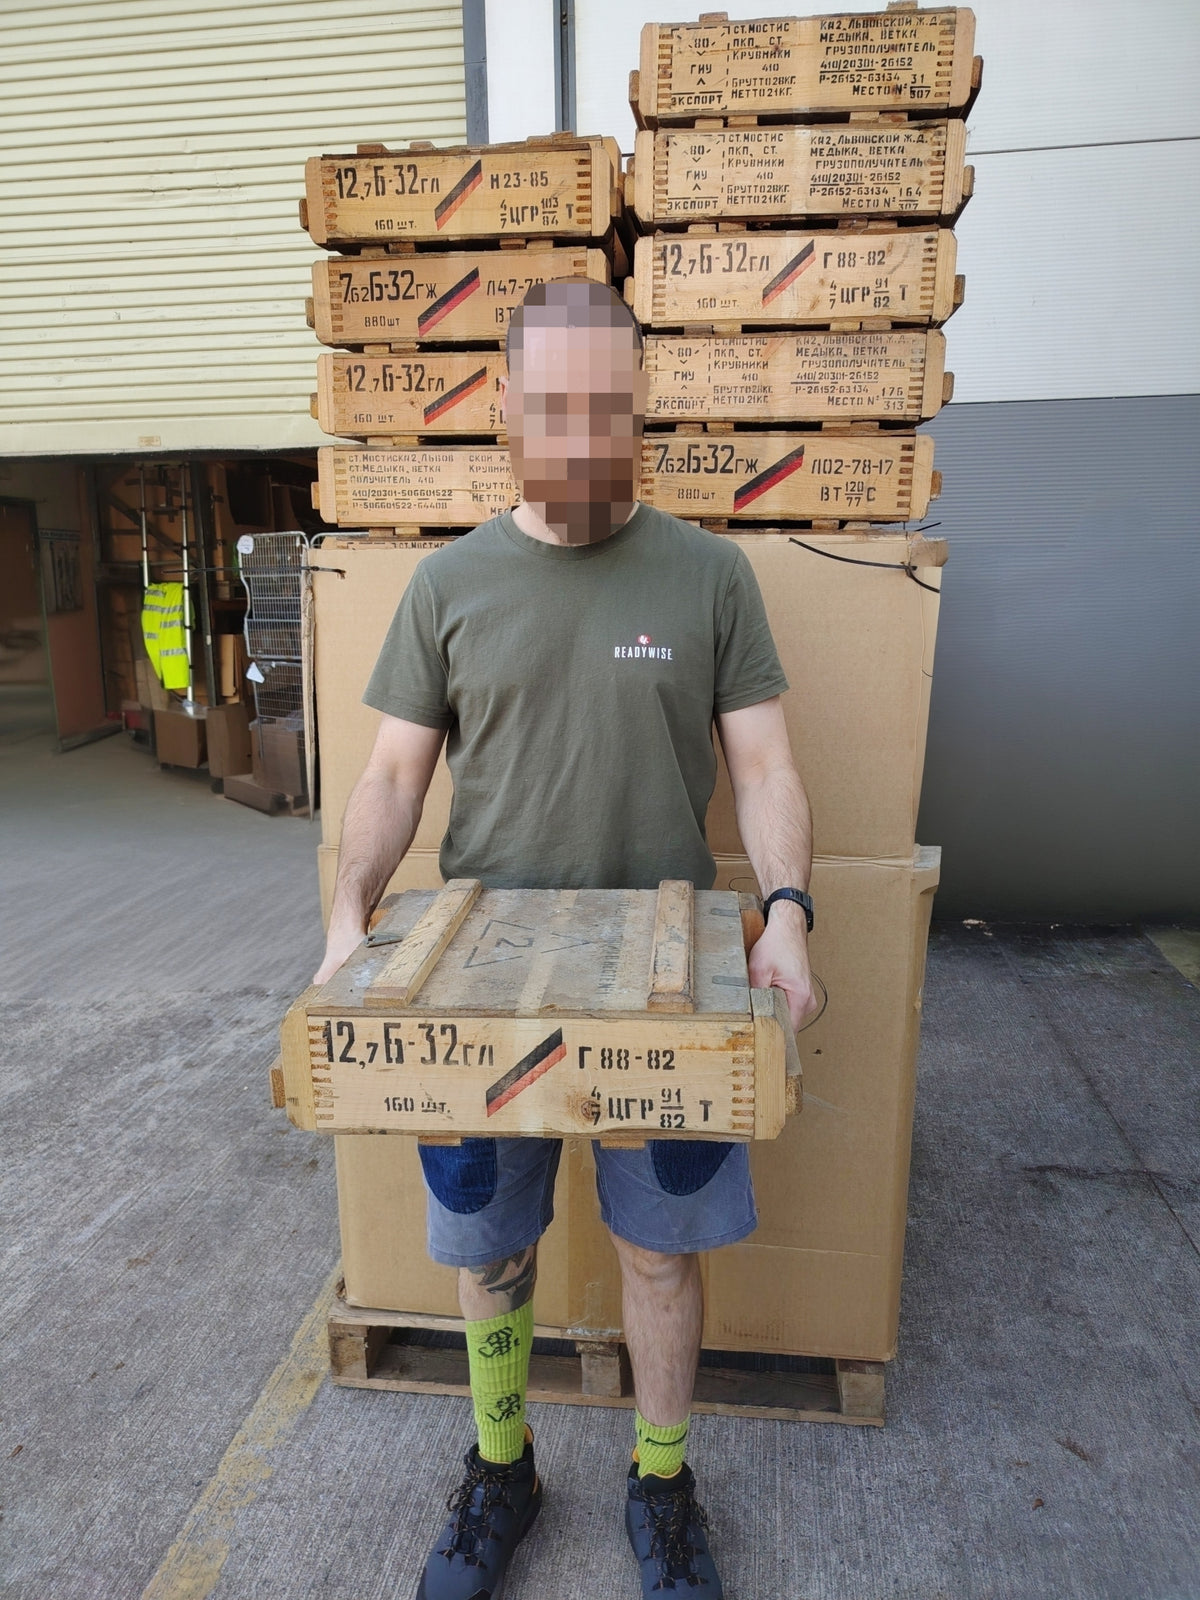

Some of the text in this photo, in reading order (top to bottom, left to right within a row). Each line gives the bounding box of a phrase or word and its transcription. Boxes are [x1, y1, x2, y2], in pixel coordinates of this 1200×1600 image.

[694, 37, 710, 48] 80
[690, 64, 712, 74] ГИУ
[762, 64, 780, 72] 410
[852, 84, 891, 96] МЕСТО
[671, 94, 723, 106] ЭКСПОРТ
[815, 158, 923, 170] ГРУЗОПОЛУЧАТЕЛЬ
[686, 170, 708, 180] ГИУ
[756, 172, 774, 180] 410
[667, 200, 718, 210] ЭКСПОРТ
[842, 198, 879, 208] МЕСТО
[374, 219, 394, 230] 160
[696, 298, 716, 308] 160
[674, 370, 695, 380] ГИУ
[742, 373, 758, 381] 410
[656, 400, 705, 410] ЭКСПОРТ
[827, 396, 864, 406] МЕСТО
[354, 414, 372, 423] 160
[614, 646, 673, 660] READYWISE
[384, 1097, 414, 1112] 160
[608, 1097, 654, 1121] ЦГР
[698, 1100, 713, 1122] Т
